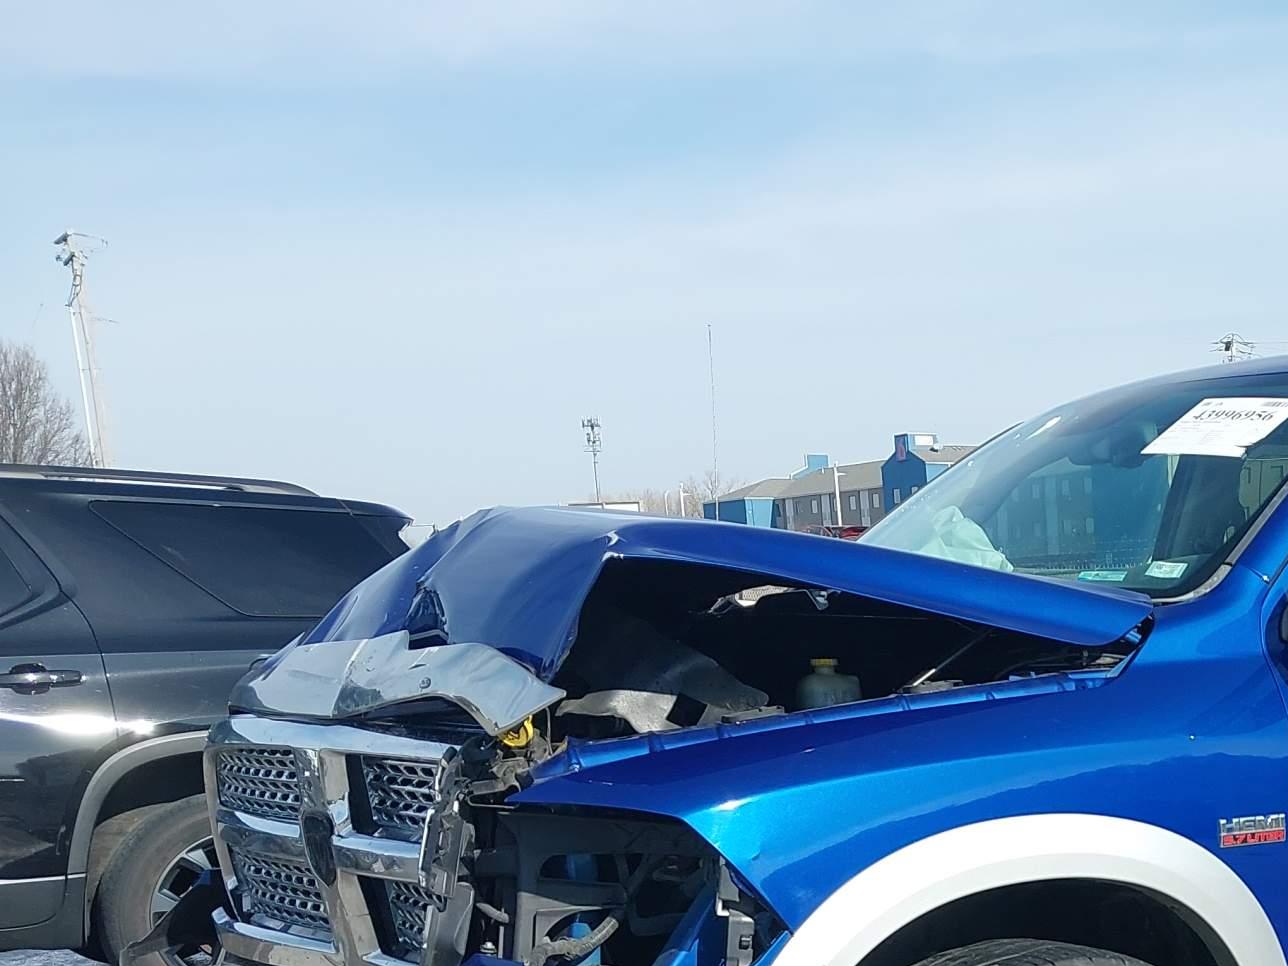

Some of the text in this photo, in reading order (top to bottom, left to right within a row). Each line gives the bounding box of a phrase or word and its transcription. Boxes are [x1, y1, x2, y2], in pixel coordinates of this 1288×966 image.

[1193, 409, 1275, 421] 43996956
[1219, 813, 1286, 833] HEMI
[1223, 830, 1284, 846] 5.7 LITER
